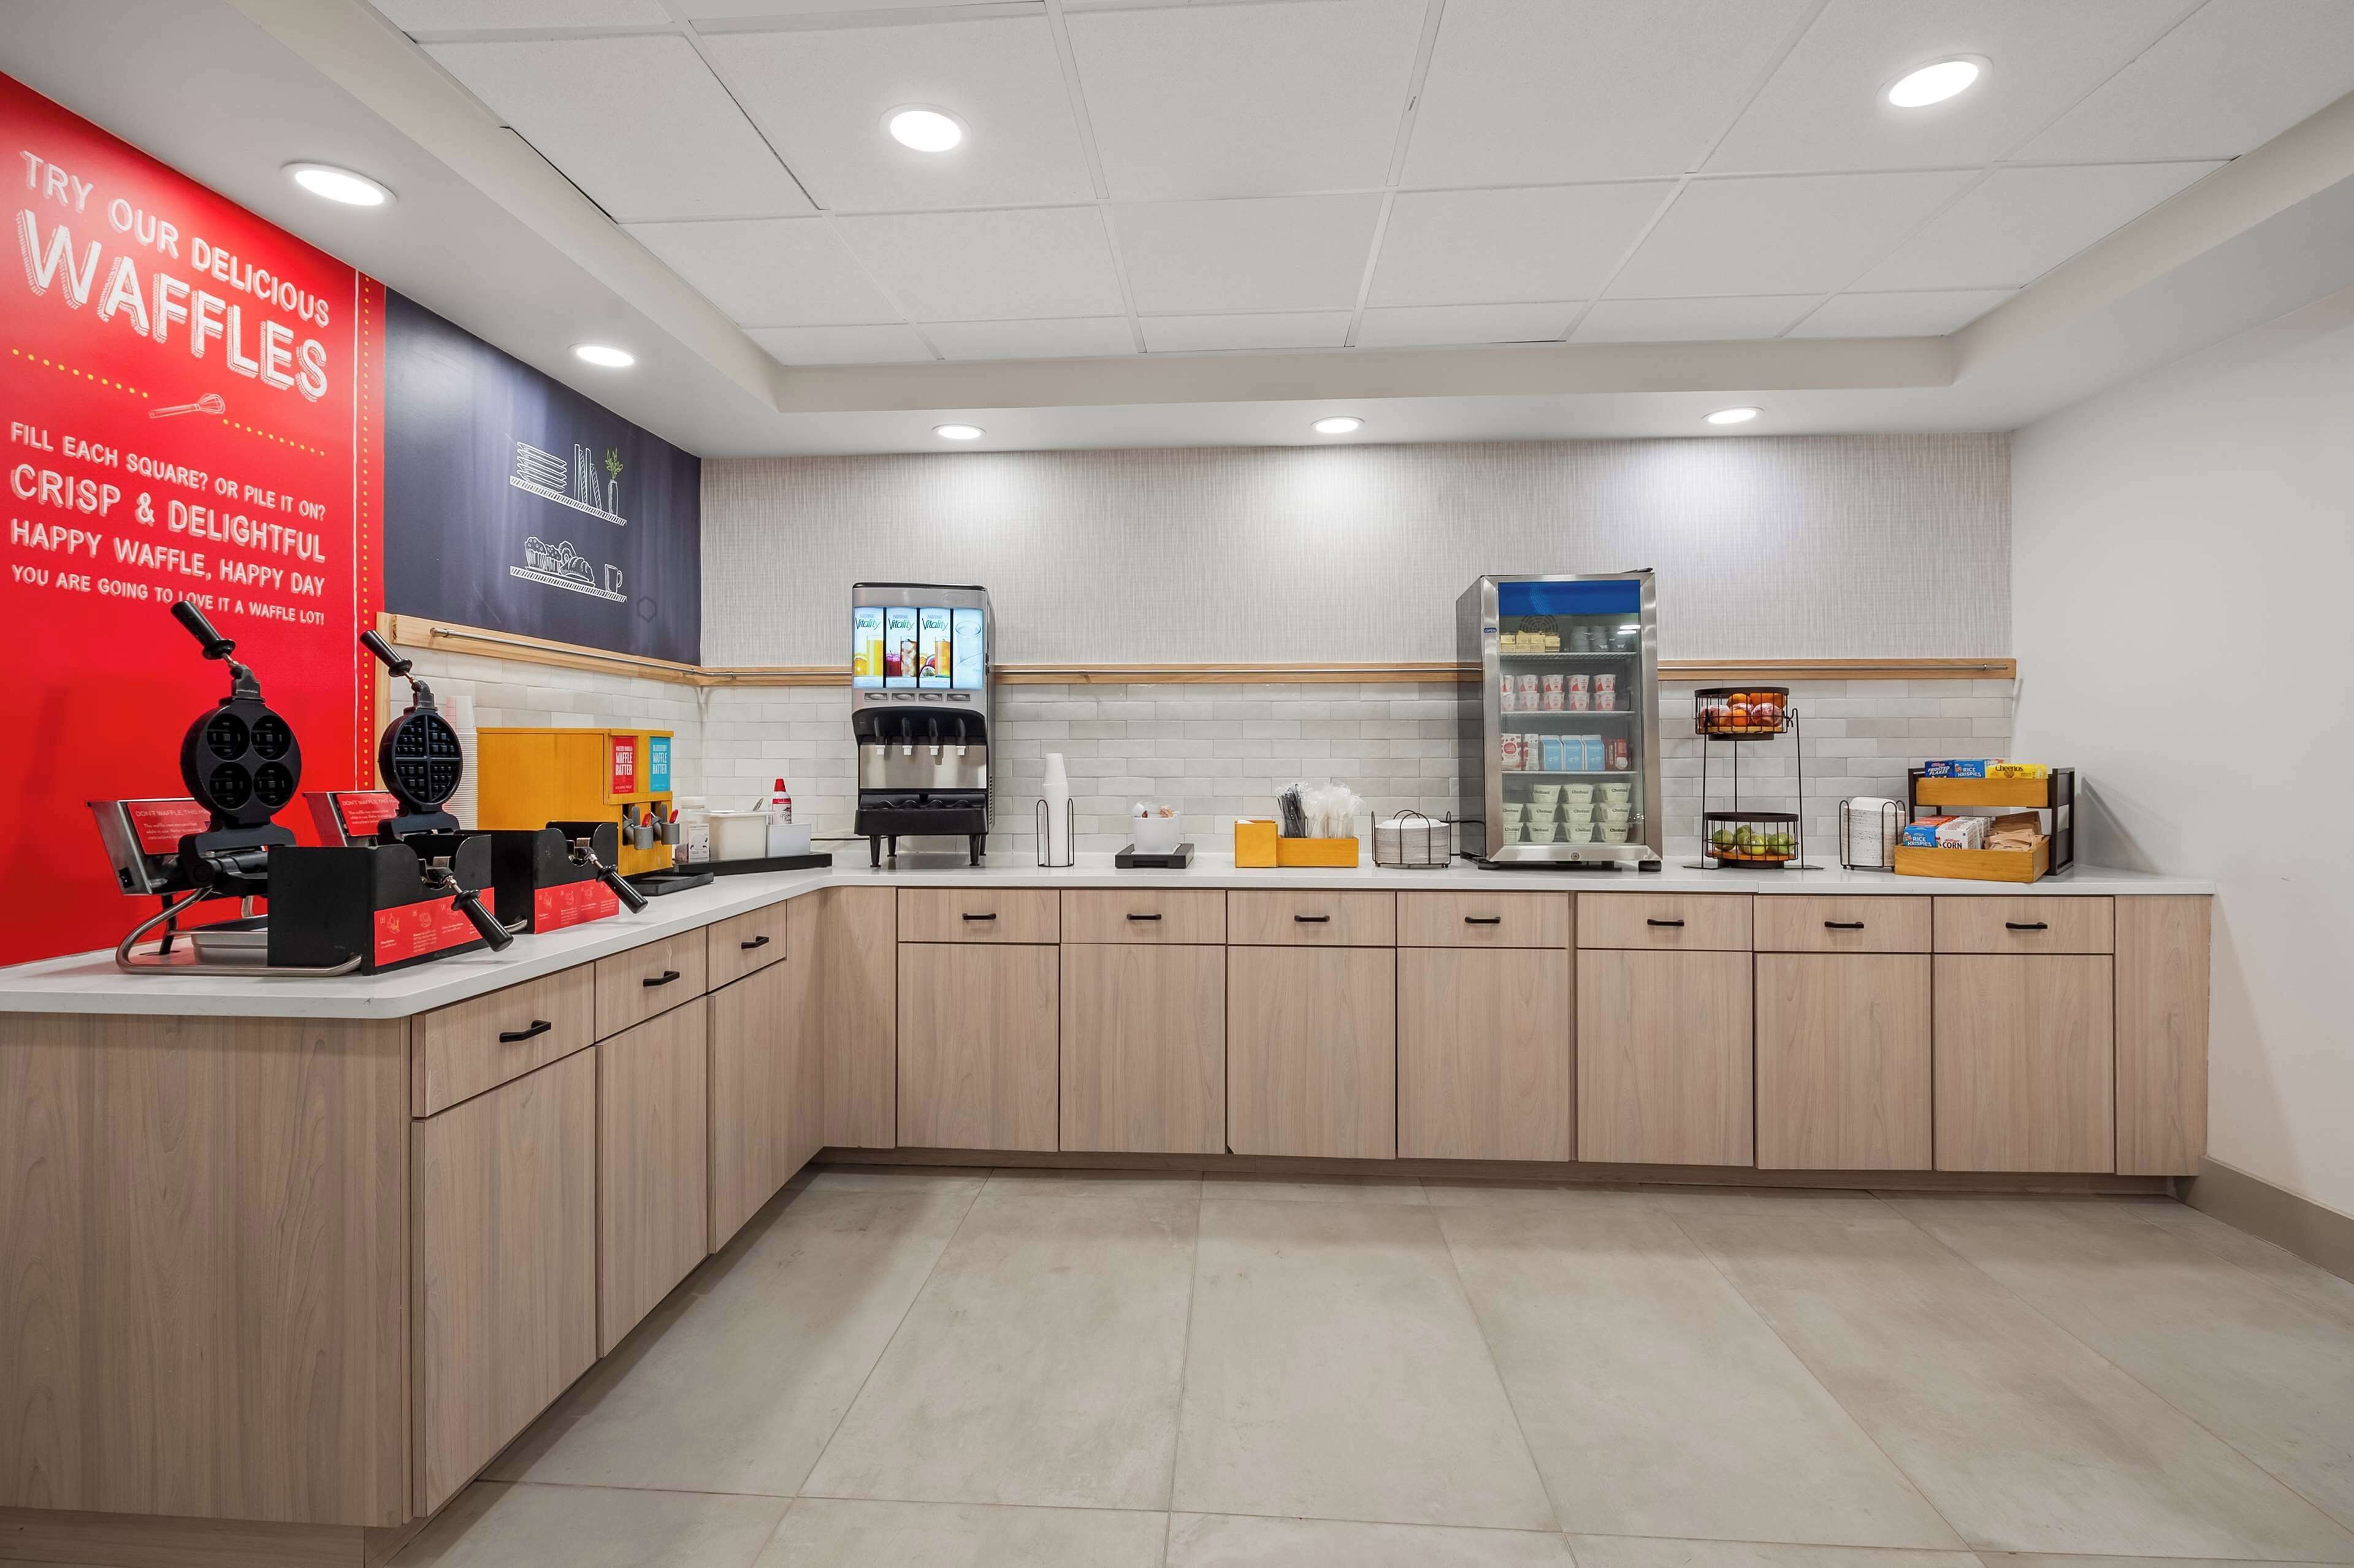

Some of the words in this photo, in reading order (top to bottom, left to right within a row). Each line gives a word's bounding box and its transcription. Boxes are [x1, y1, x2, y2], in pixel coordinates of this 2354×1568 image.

[19, 150, 93, 213] TRY
[108, 198, 179, 259] OUR
[191, 237, 329, 327] DELICIOUS
[16, 208, 327, 402] WAFFLES
[11, 421, 53, 451] FILL
[63, 436, 118, 467] EACH
[126, 453, 208, 491] SQUARE?
[215, 478, 238, 499] OR
[244, 484, 275, 508] PILE
[281, 495, 294, 513] IT
[299, 500, 326, 521] ON?
[12, 464, 121, 516] CRISP
[137, 492, 155, 527] &
[167, 500, 326, 563] DELIGHTFUL
[10, 518, 102, 557] HAPPY
[114, 537, 212, 581] WAFFLE,
[220, 559, 284, 589] HAPPY
[290, 572, 325, 597] DAY
[12, 564, 48, 586] YOU
[56, 572, 91, 592] ARE
[97, 578, 148, 600] GOING
[154, 586, 173, 603] TO
[218, 597, 231, 612] IT
[235, 599, 243, 614] A
[250, 601, 296, 622] WAFFLE
[300, 609, 324, 626] LOT!
[855, 617, 881, 630] Vitality
[888, 618, 915, 631] Vitality
[922, 618, 948, 632] Vitality
[616, 752, 633, 763] WAFFLE
[652, 752, 667, 763] WAFFLE
[615, 764, 633, 776] BATTER
[652, 763, 667, 774] BATTER
